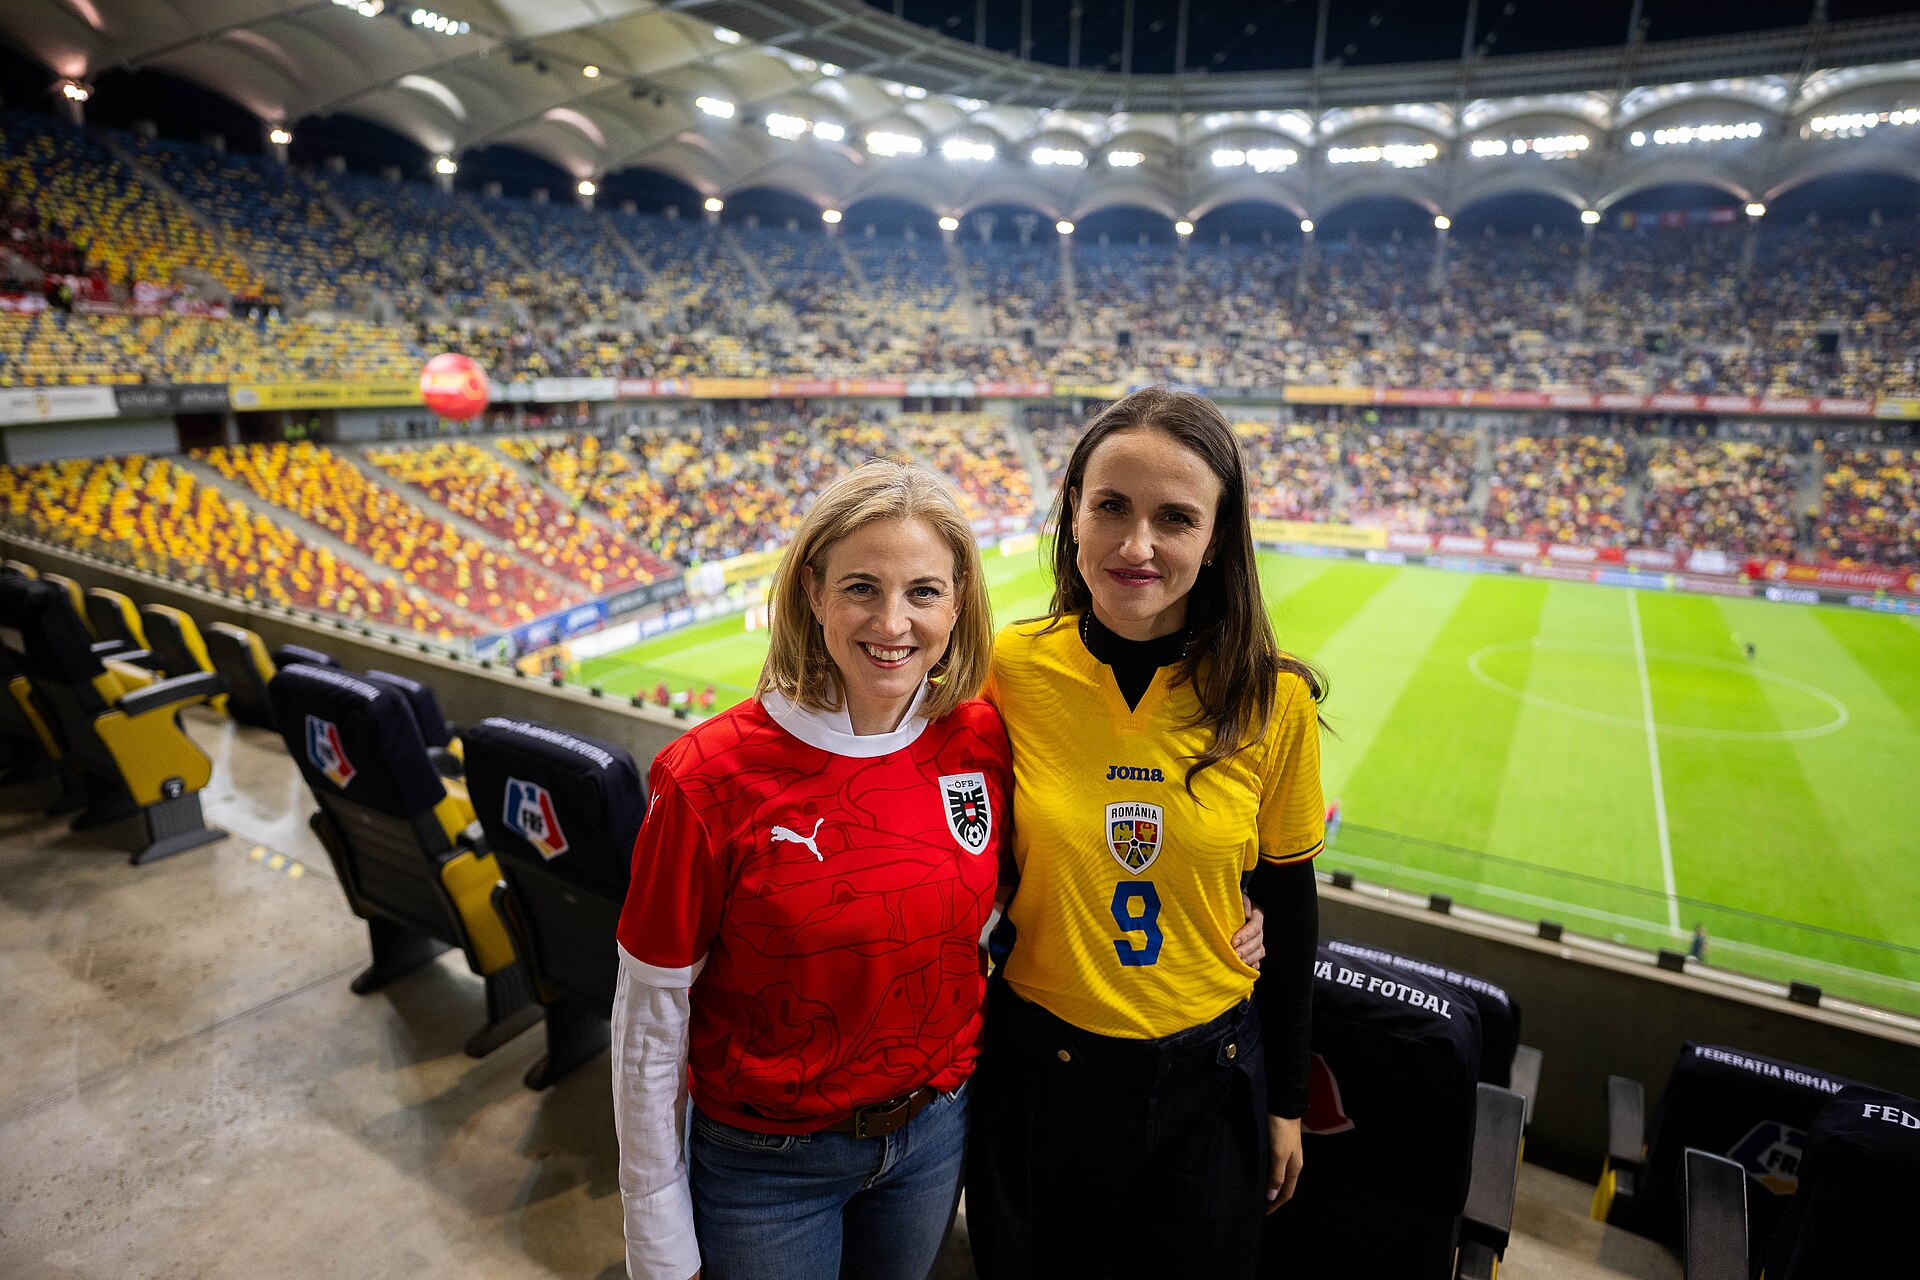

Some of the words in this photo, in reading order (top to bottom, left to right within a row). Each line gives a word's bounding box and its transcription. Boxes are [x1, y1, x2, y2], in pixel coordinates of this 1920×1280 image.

[1111, 803, 1158, 820] ROMÂNIA
[1110, 880, 1164, 967] 9
[1336, 967, 1366, 989] DE
[1367, 976, 1452, 1020] FOTBAL
